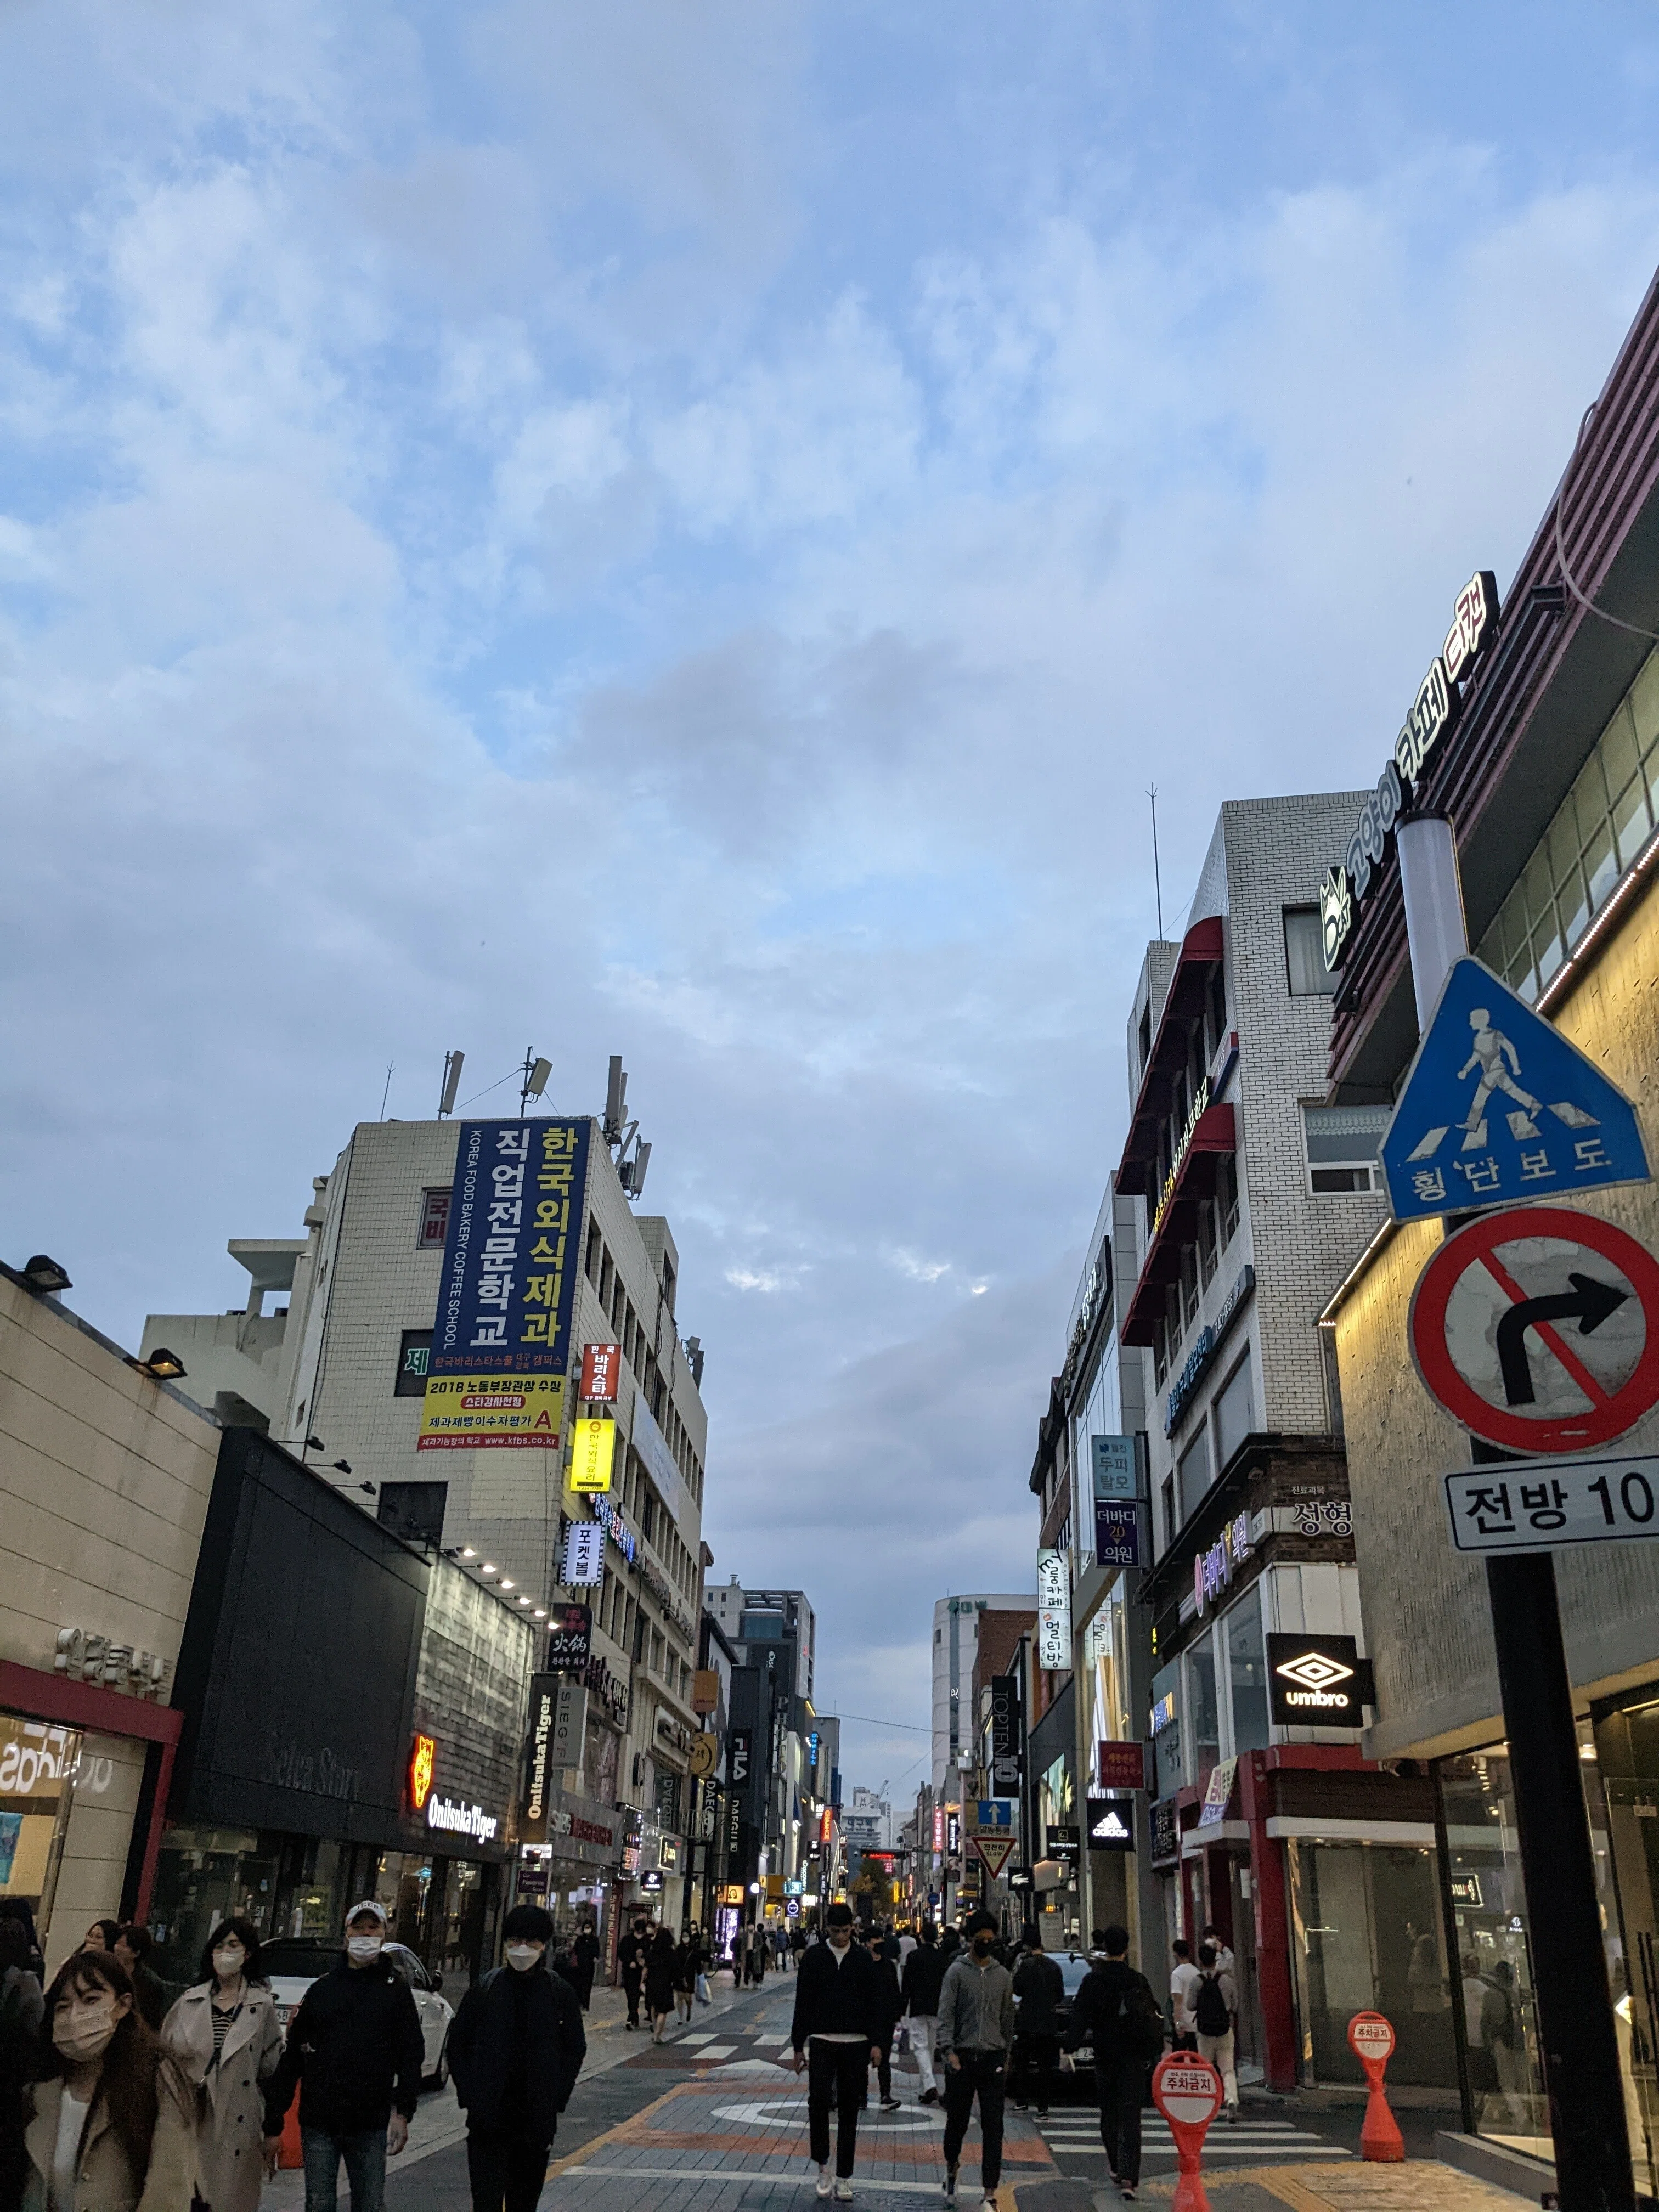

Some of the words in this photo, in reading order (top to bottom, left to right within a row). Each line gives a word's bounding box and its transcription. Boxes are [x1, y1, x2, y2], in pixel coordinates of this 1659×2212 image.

[1349, 769, 1400, 895] 고양이
[1398, 664, 1446, 765] 카페
[1445, 579, 1482, 675] 디캣
[467, 1130, 482, 1168] KOREA
[464, 1170, 477, 1201] FOOD
[1412, 1138, 1613, 1201] 횡단보도
[457, 1203, 473, 1249] BAKERY
[470, 1128, 531, 1347] 직업전문학교
[520, 1127, 579, 1348] 한국외식제과
[450, 1251, 465, 1297] COFFEE
[444, 1300, 460, 1349] SCHOOL
[435, 1355, 513, 1368] 한국바리스타스쿨
[533, 1354, 562, 1366] 캠퍼스
[591, 1345, 615, 1354] 한국
[430, 1381, 464, 1393] 2018
[467, 1380, 535, 1393] 노동부장관상
[538, 1380, 561, 1393] 수상
[591, 1355, 610, 1395] 바리스타
[429, 1415, 532, 1427] 제과제빵이수자평가
[533, 1410, 552, 1429] A
[466, 1436, 481, 1444] 학교
[484, 1435, 556, 1446] www.kfbs.co.kr
[585, 1434, 599, 1481] 한국외식요리
[1099, 1457, 1128, 1472] 두피
[1100, 1475, 1130, 1491] 탈모
[1097, 1509, 1136, 1525] 더바디
[1291, 1502, 1353, 1536] 성형
[1465, 1479, 1568, 1534] 전방
[1108, 1526, 1125, 1537] 20
[575, 1529, 592, 1577] 포켓볼
[1104, 1546, 1132, 1564] 의원
[1046, 1620, 1063, 1668] 멀티방
[1286, 1690, 1349, 1707] umbro
[993, 1690, 1009, 1756] TOPTEN
[733, 1737, 748, 1780] FILA
[984, 1843, 1005, 1852] 천천히
[1092, 1827, 1128, 1837] adidas
[1358, 2028, 1388, 2038] 주차금지
[1166, 2077, 1211, 2091] 주차금지
